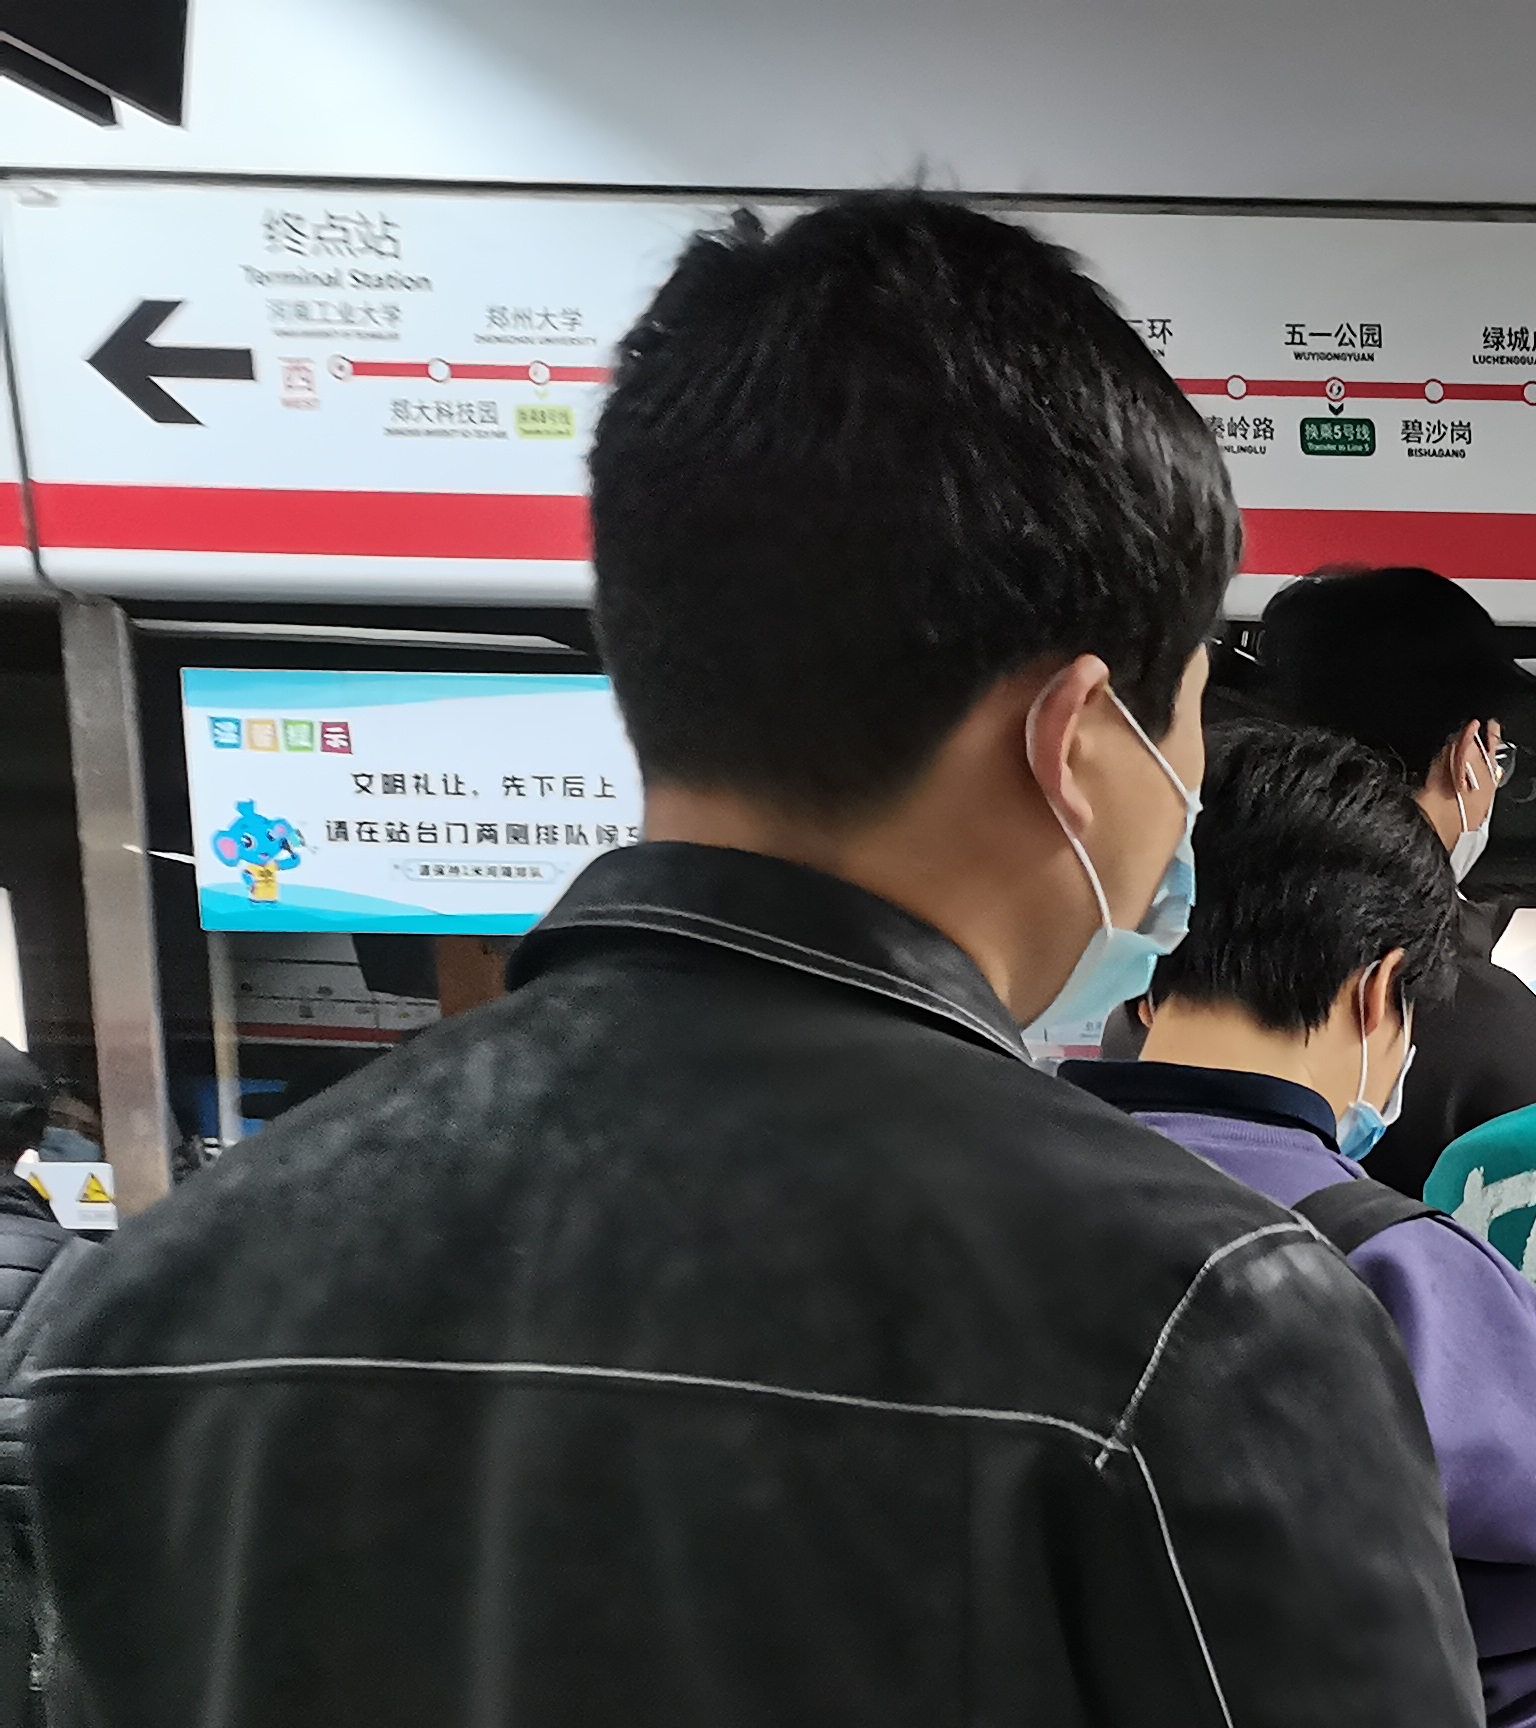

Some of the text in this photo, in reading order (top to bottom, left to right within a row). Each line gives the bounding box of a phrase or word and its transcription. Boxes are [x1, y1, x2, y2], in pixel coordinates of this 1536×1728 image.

[486, 304, 583, 332] 郑州大学
[1284, 323, 1383, 349] 五一公园
[1293, 351, 1375, 362] WUYIGONGYUAN
[1304, 423, 1372, 443] 换乘5号线
[1401, 419, 1472, 446] 碧沙岗
